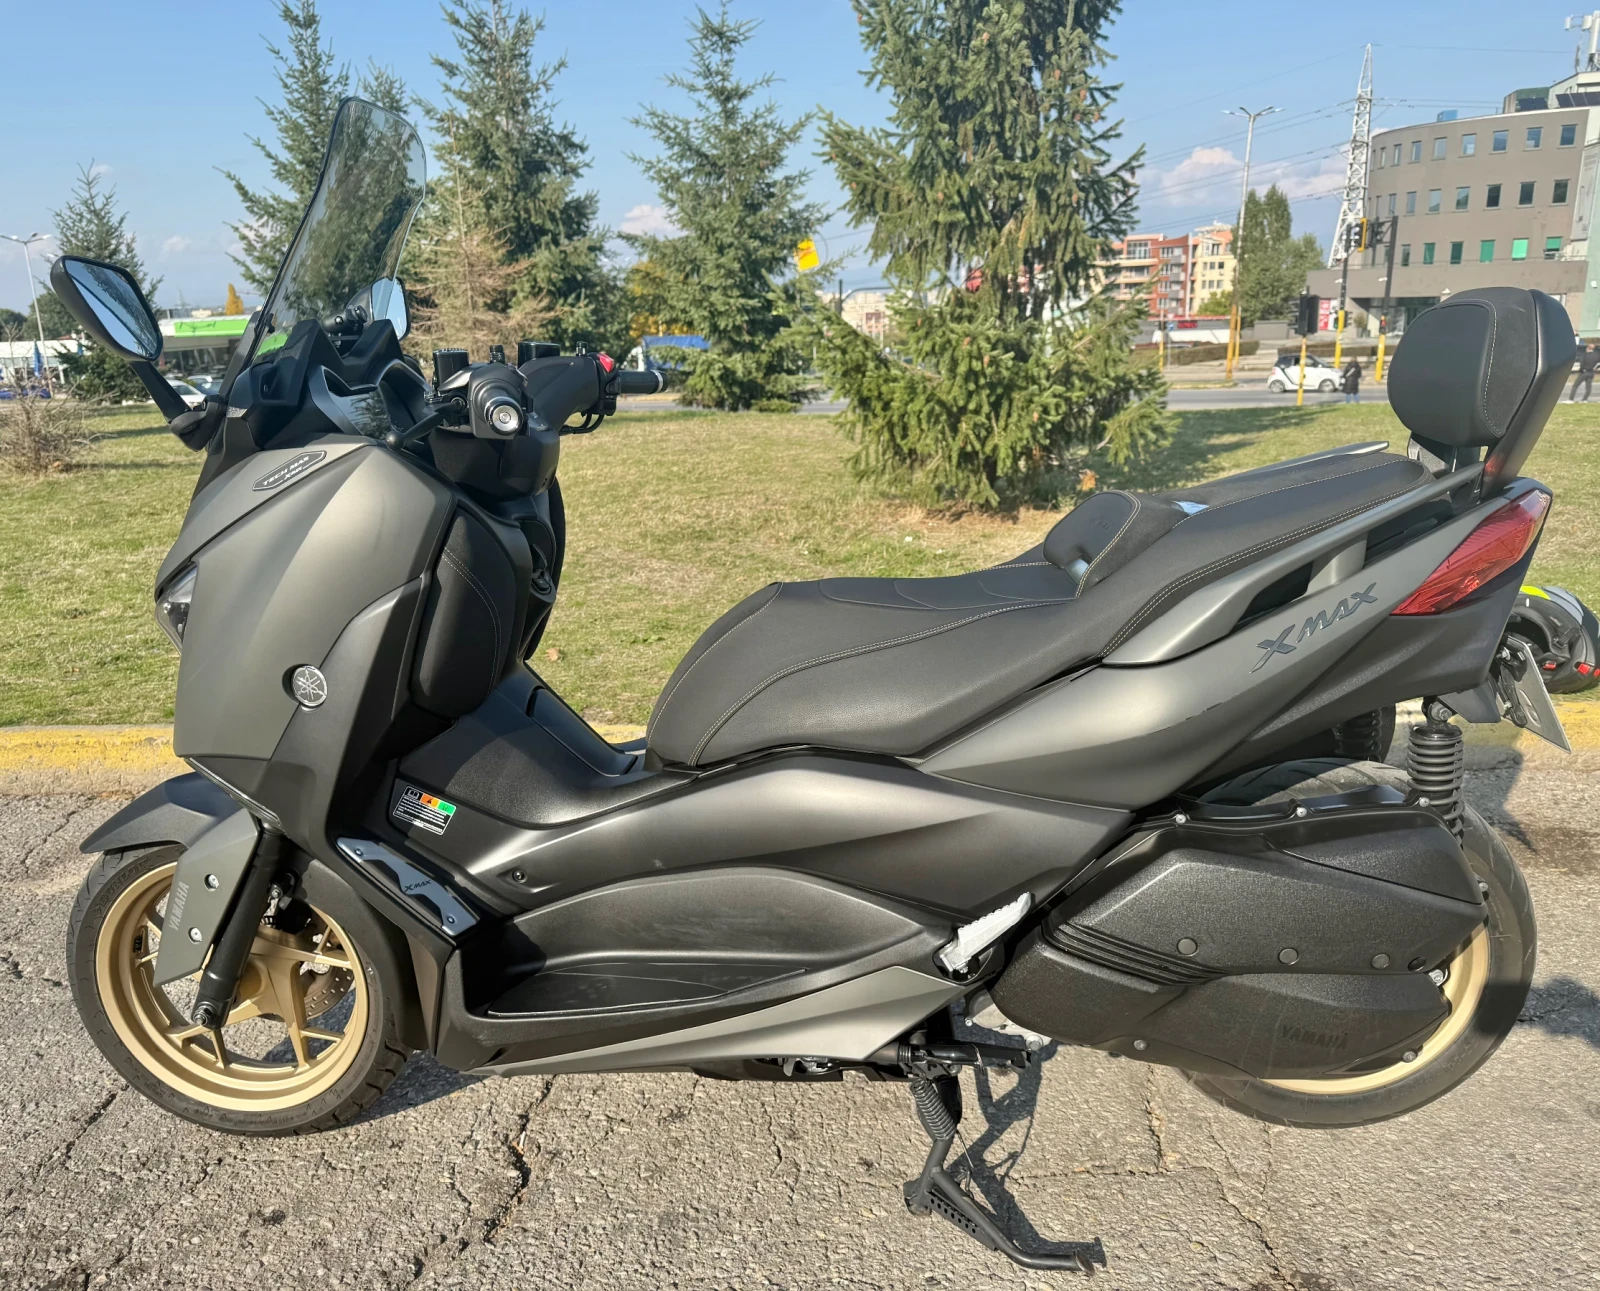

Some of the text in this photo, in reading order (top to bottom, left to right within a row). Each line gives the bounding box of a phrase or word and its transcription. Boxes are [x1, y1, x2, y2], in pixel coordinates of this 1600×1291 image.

[263, 455, 310, 486] TECH MAX
[168, 880, 190, 932] YAMAHA
[1282, 1024, 1348, 1050] YAMAHA
